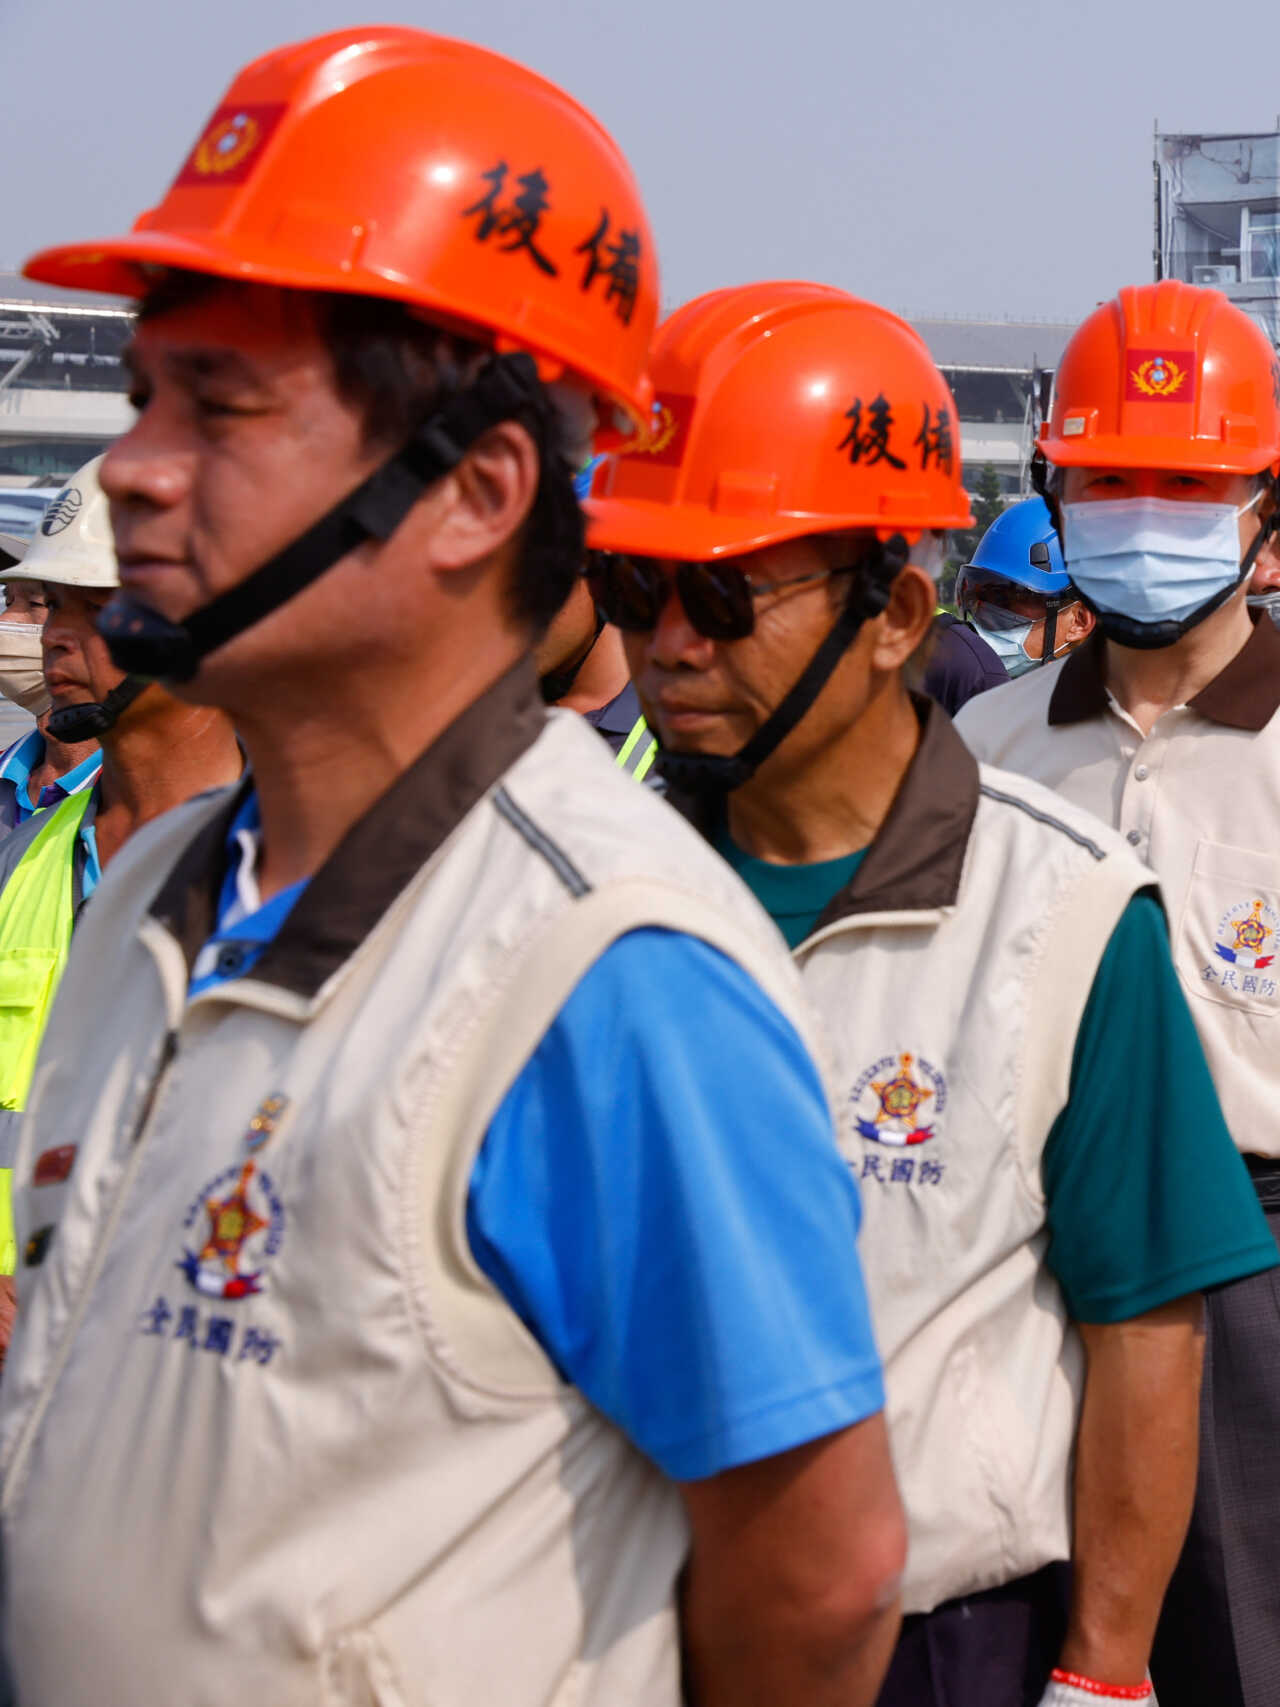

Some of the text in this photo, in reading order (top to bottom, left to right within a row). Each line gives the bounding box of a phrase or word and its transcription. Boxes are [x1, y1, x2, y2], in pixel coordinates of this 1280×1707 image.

[837, 392, 953, 477] 後備
[1201, 964, 1276, 996] 全民國防
[847, 1153, 946, 1185] 民國防
